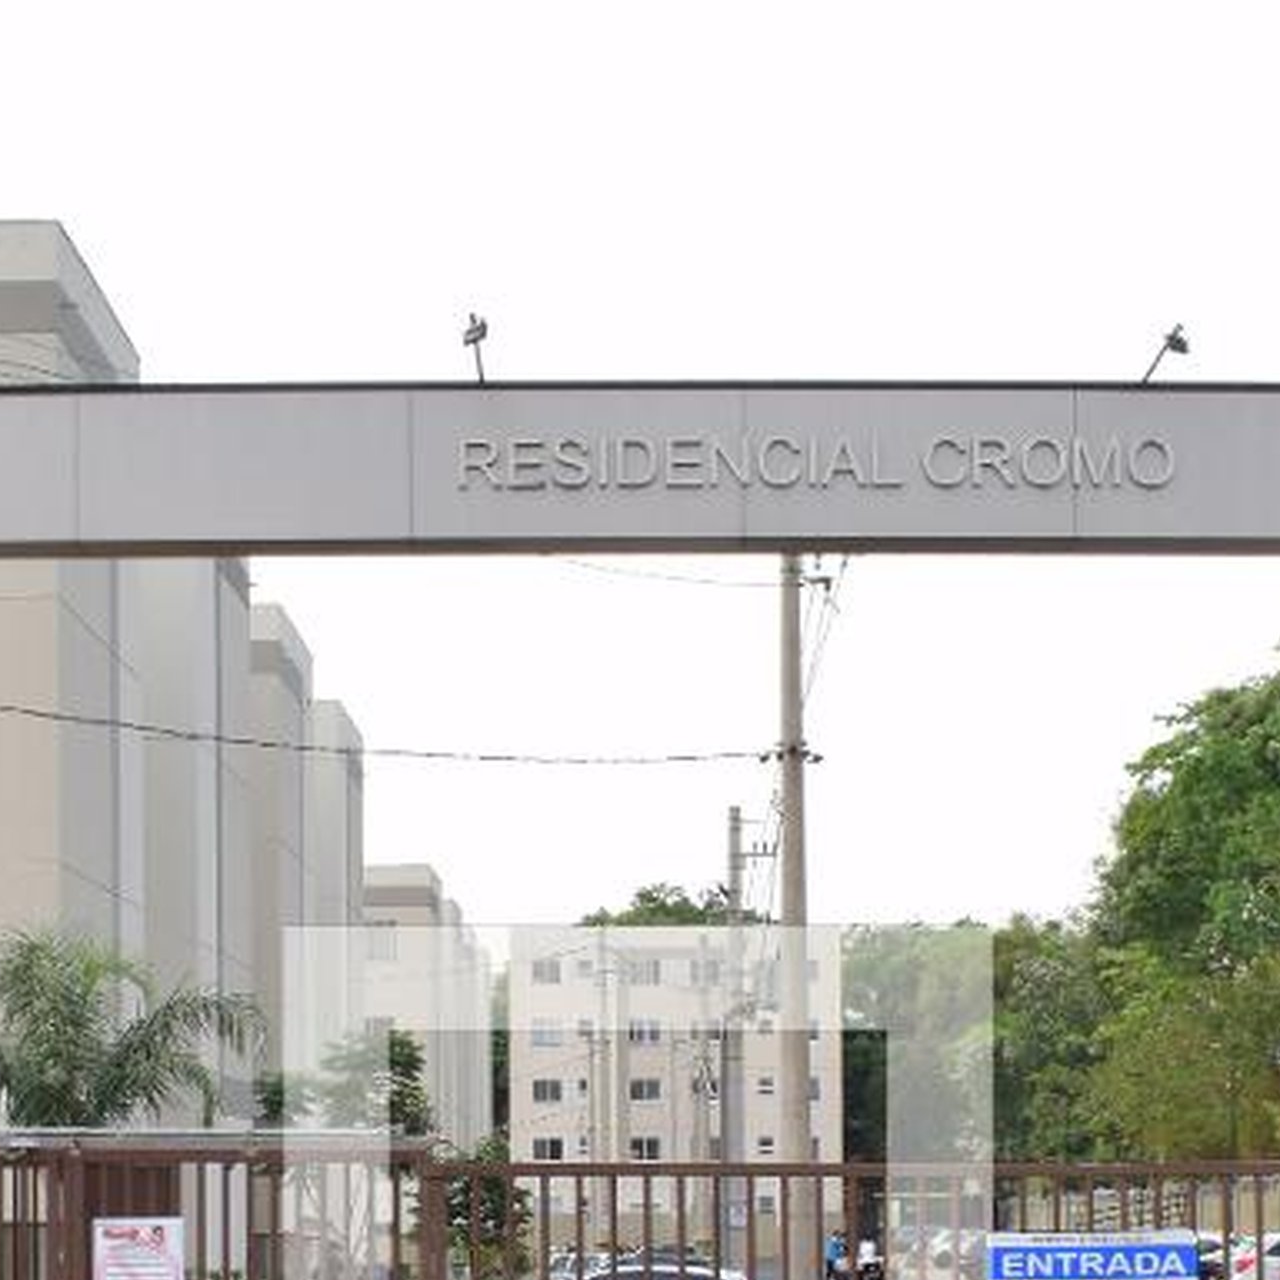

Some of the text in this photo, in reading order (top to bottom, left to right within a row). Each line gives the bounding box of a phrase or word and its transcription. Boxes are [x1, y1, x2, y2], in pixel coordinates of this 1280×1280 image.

[458, 434, 1176, 492] RESIDENCIAL CROMO
[1001, 1251, 1187, 1278] ENTRADA
